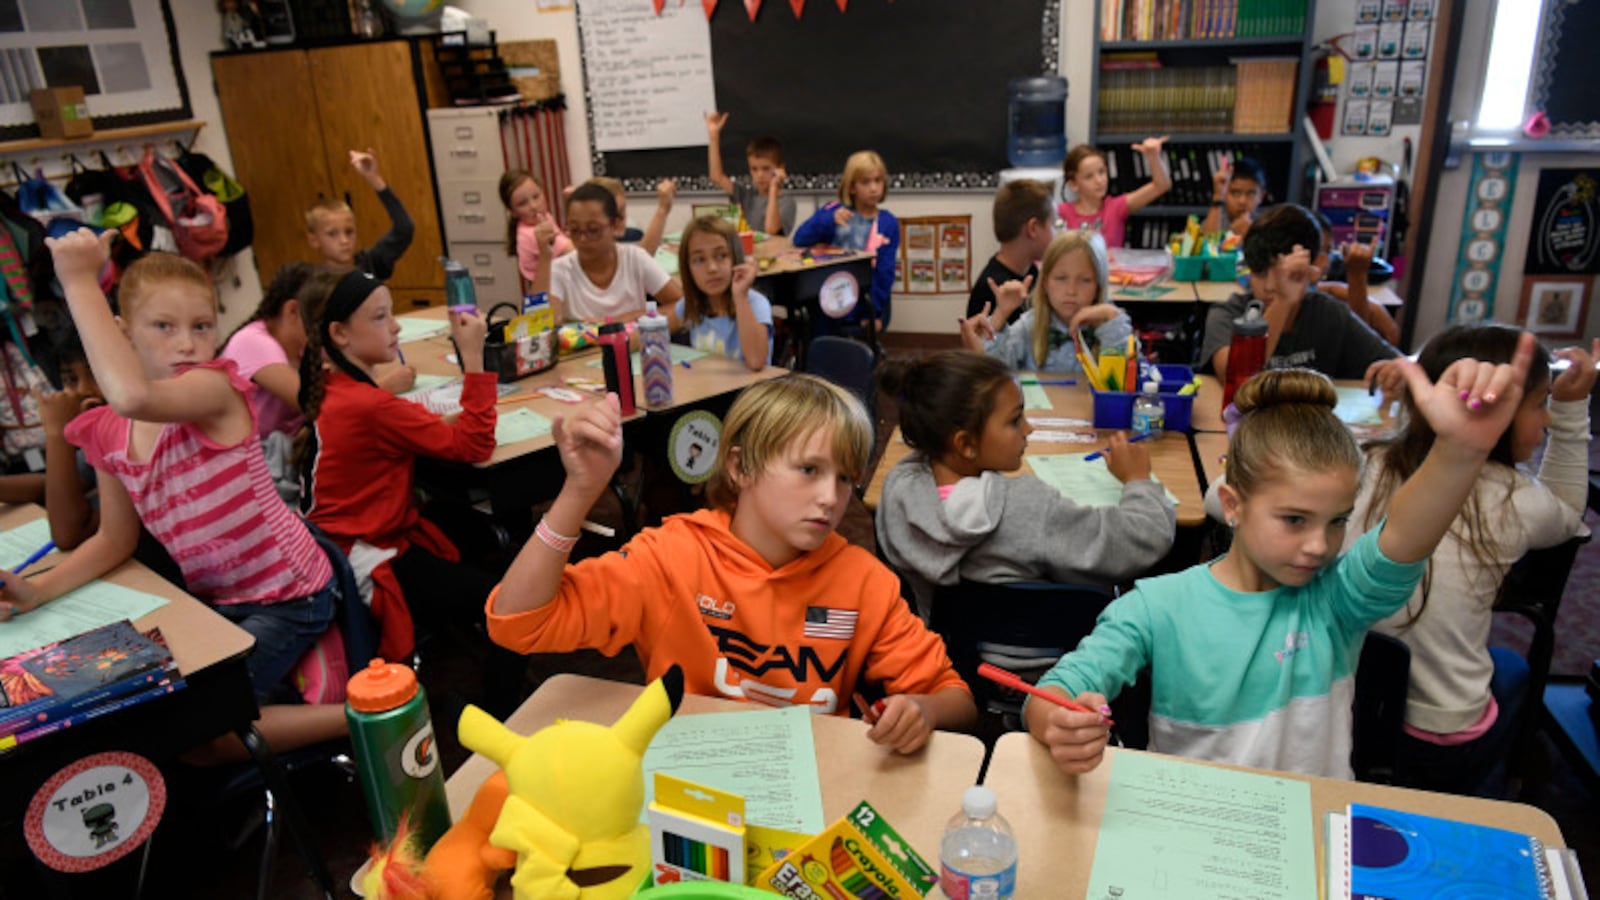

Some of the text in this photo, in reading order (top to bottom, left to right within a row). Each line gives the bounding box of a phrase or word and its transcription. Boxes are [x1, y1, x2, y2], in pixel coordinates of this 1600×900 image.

[529, 336, 540, 354] 5
[706, 624, 850, 682] TEAM
[52, 773, 133, 812] Table 4
[855, 806, 876, 827] 12
[843, 838, 900, 896] Crayola
